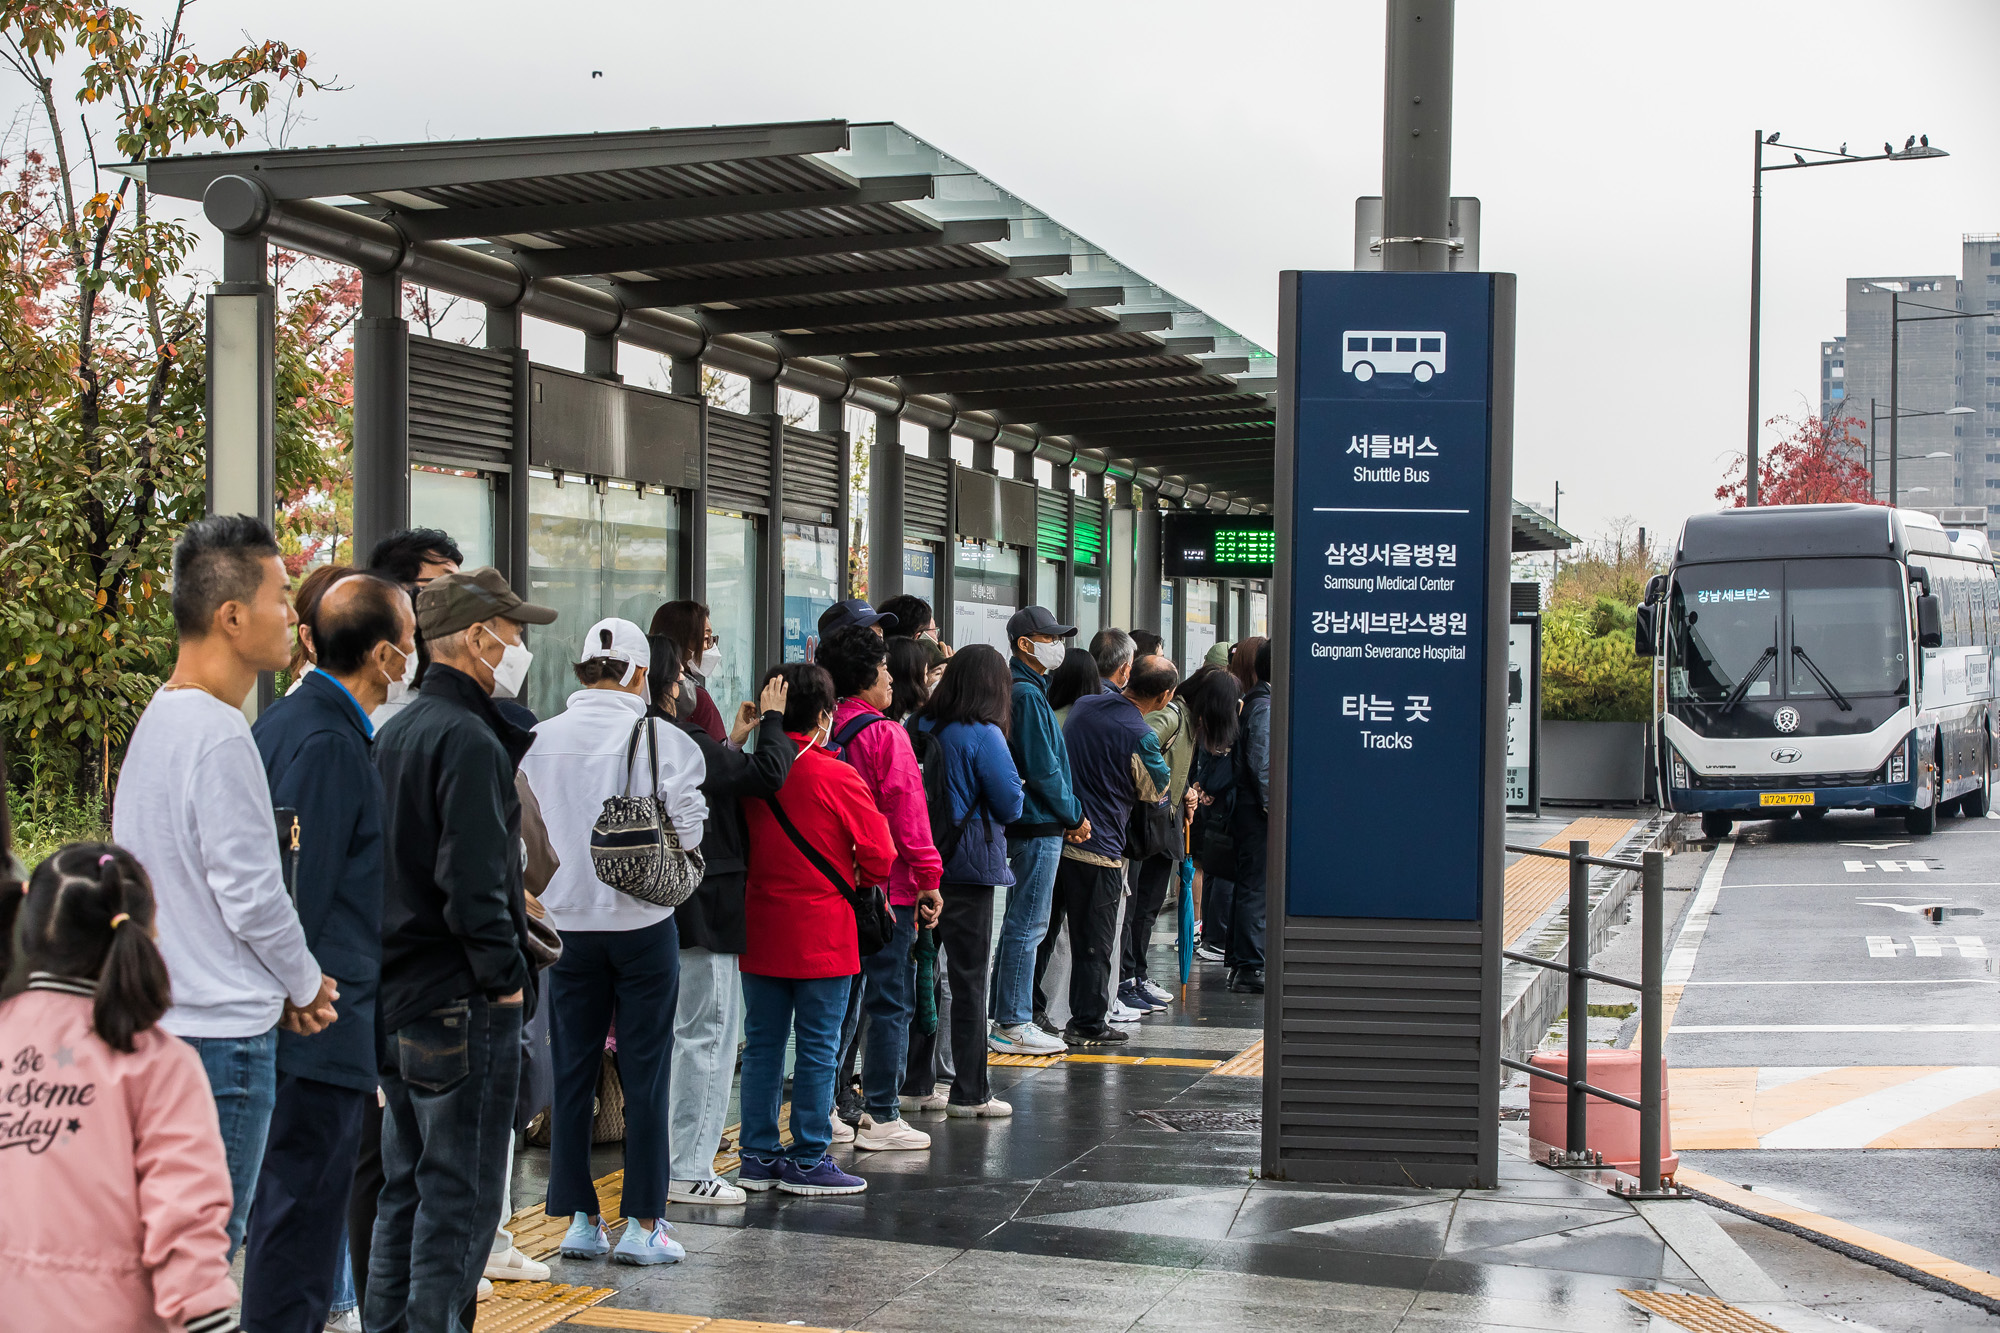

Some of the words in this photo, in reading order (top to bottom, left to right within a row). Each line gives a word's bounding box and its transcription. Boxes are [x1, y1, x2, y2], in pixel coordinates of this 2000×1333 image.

[1346, 434, 1440, 459] 셔틀버스
[1353, 466, 1401, 483] Shuttle
[1403, 466, 1430, 483] Bus
[1324, 542, 1457, 568] 삼성서울병원
[1323, 574, 1374, 593] Samsung
[1376, 575, 1418, 591] Medical
[1419, 575, 1456, 592] Center
[1697, 587, 1771, 603] 강남세브란스
[1311, 610, 1467, 636] 강남세브란스병원
[1311, 642, 1363, 661] Gangnam
[1364, 643, 1421, 659] Severance
[1422, 644, 1466, 663] Hospital
[1342, 693, 1395, 722] 타는
[1404, 695, 1432, 723] 곳
[1359, 730, 1413, 750] Tracks
[1787, 794, 1811, 804] 7790
[12, 1044, 46, 1076] Be
[0, 1077, 97, 1109] esome
